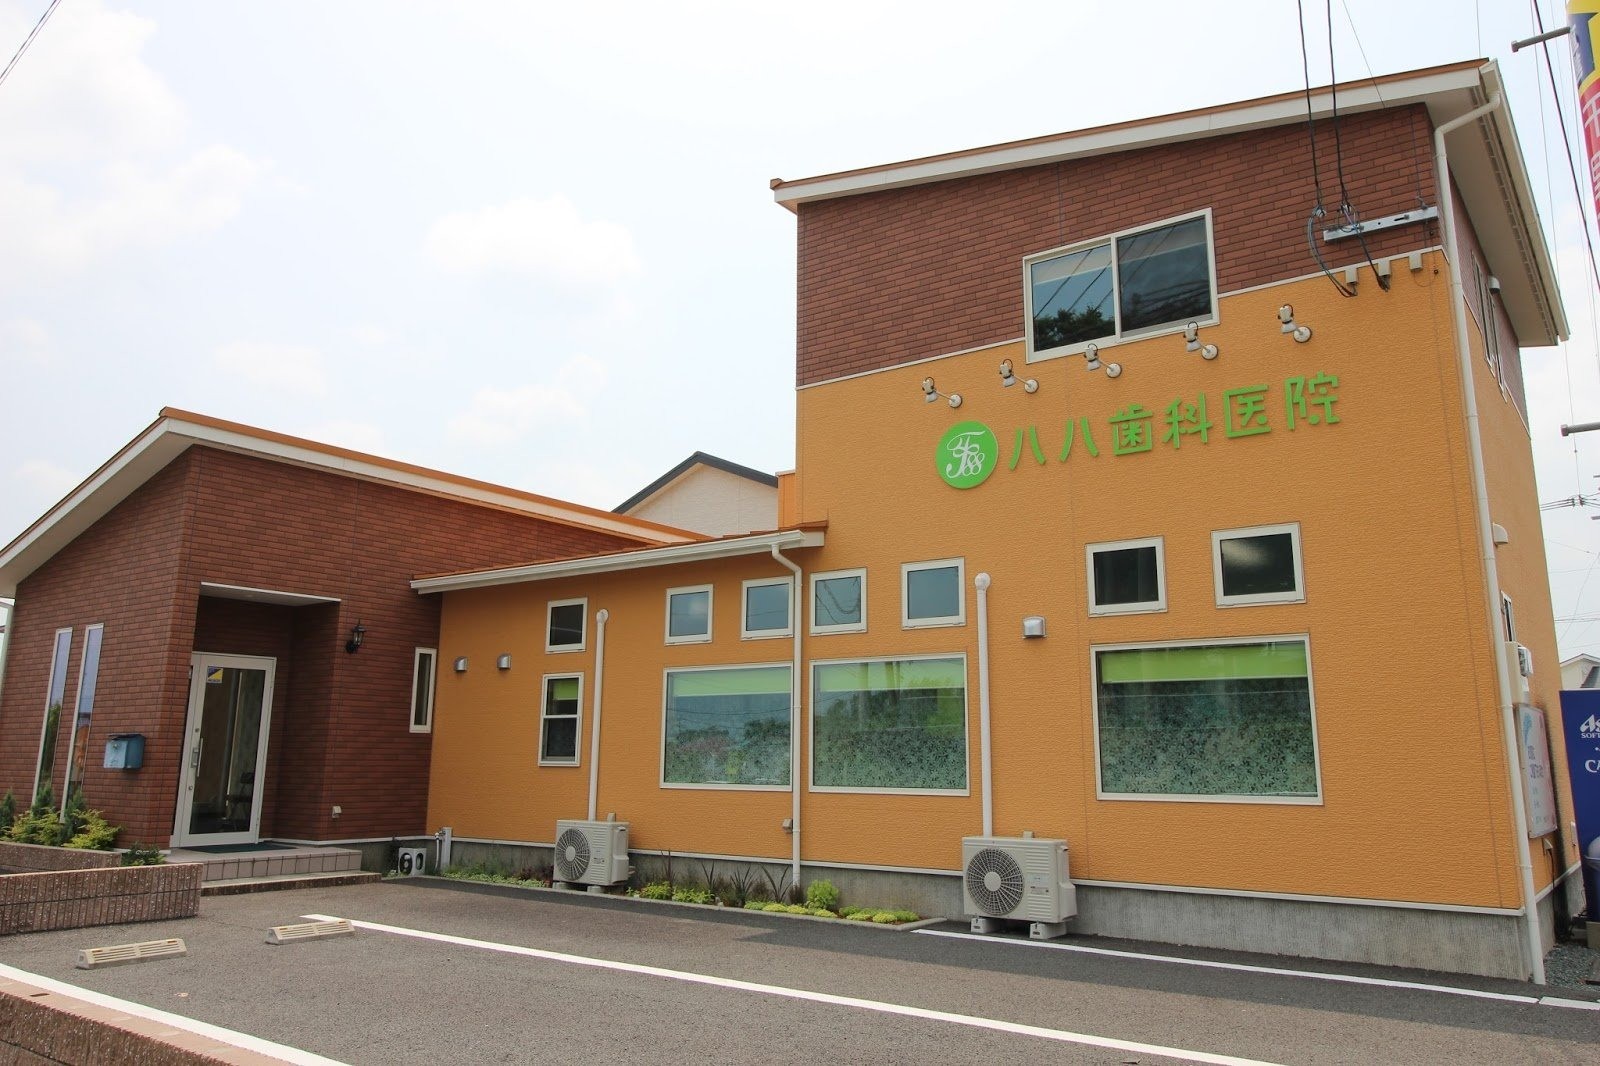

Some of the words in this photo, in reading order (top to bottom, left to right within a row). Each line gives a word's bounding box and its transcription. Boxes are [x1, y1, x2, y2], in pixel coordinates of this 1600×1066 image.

[1009, 371, 1340, 470] 八八歯科医院
